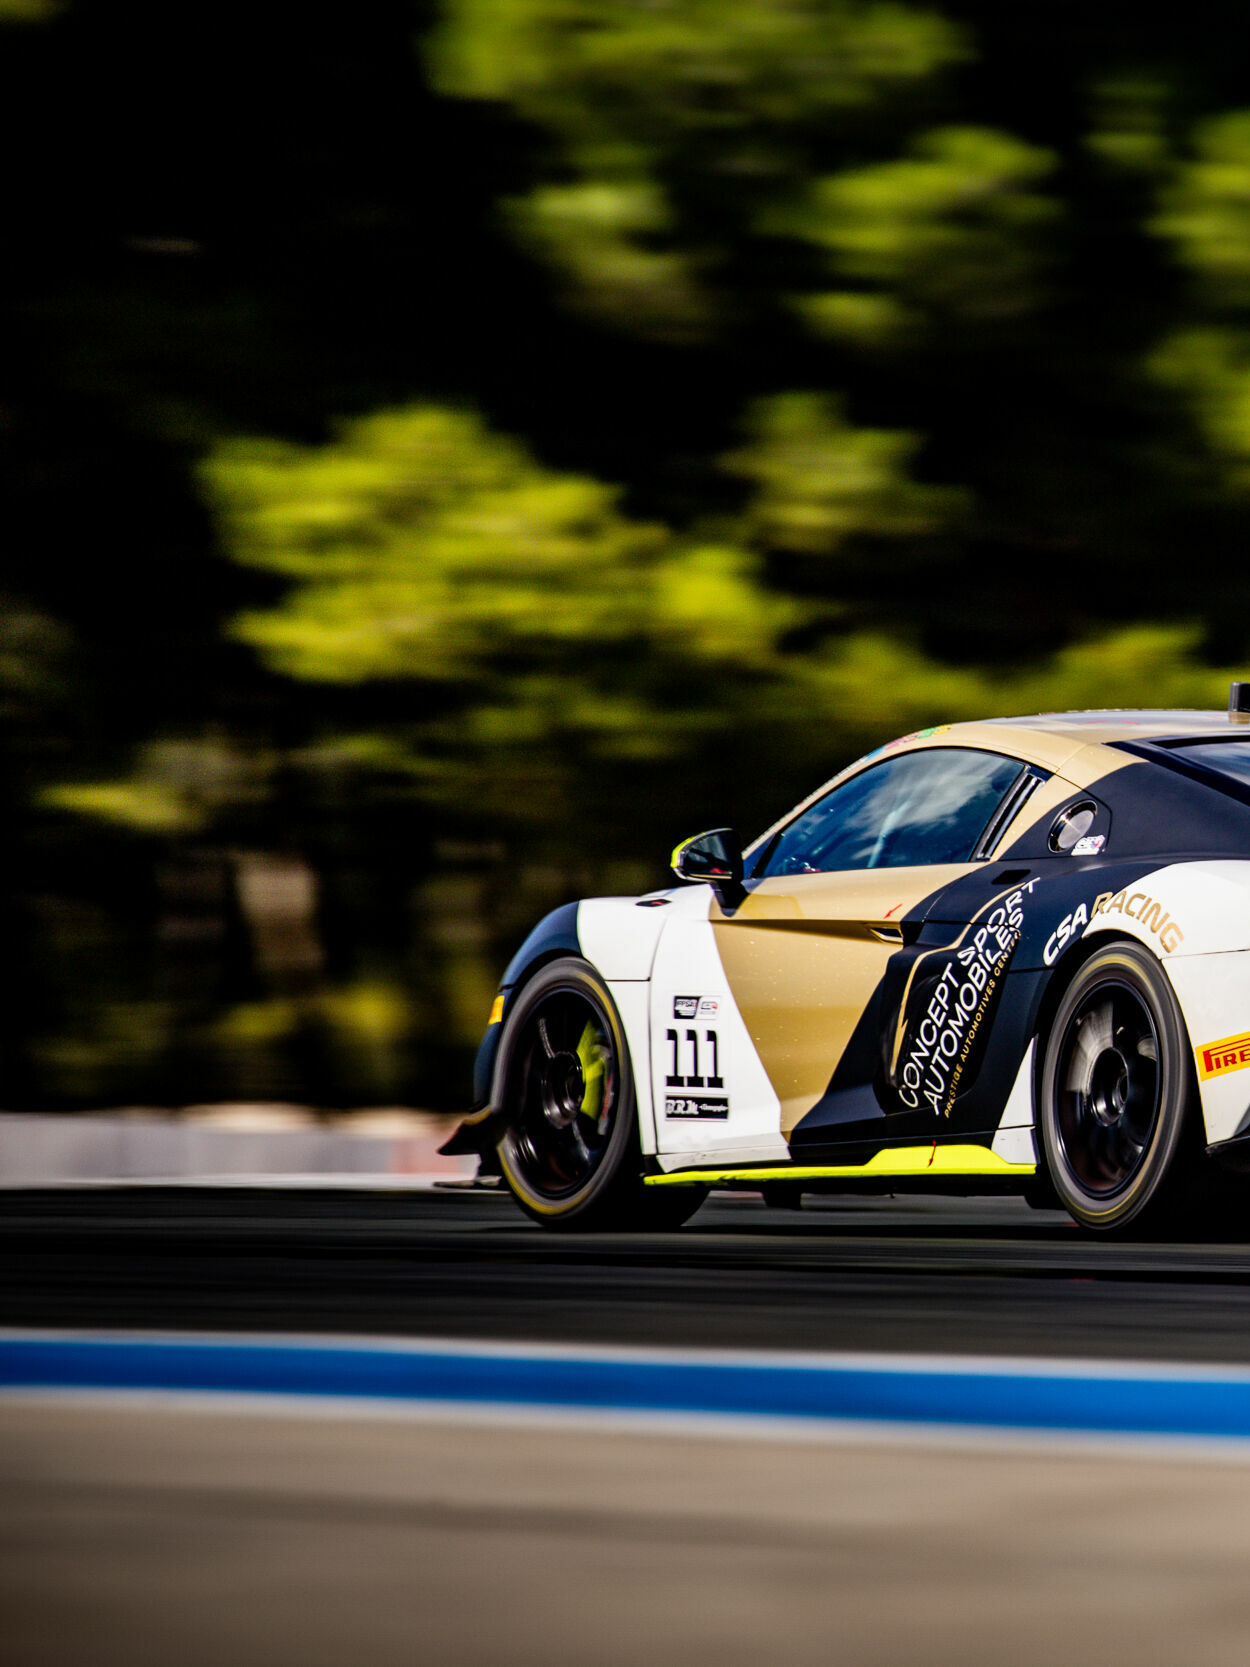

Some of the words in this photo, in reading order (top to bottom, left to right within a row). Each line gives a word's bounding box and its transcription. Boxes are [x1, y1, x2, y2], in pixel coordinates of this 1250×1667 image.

[898, 962, 959, 1108] CONCEPT
[957, 876, 1041, 966] SPORT
[1043, 903, 1088, 967] CSA
[1091, 890, 1185, 953] RACING
[666, 1028, 724, 1089] 111
[923, 908, 1024, 1116] AUTOMOBILES
[944, 1064, 964, 1118] PRESTIGE
[960, 979, 997, 1063] AUTOMOTIVES
